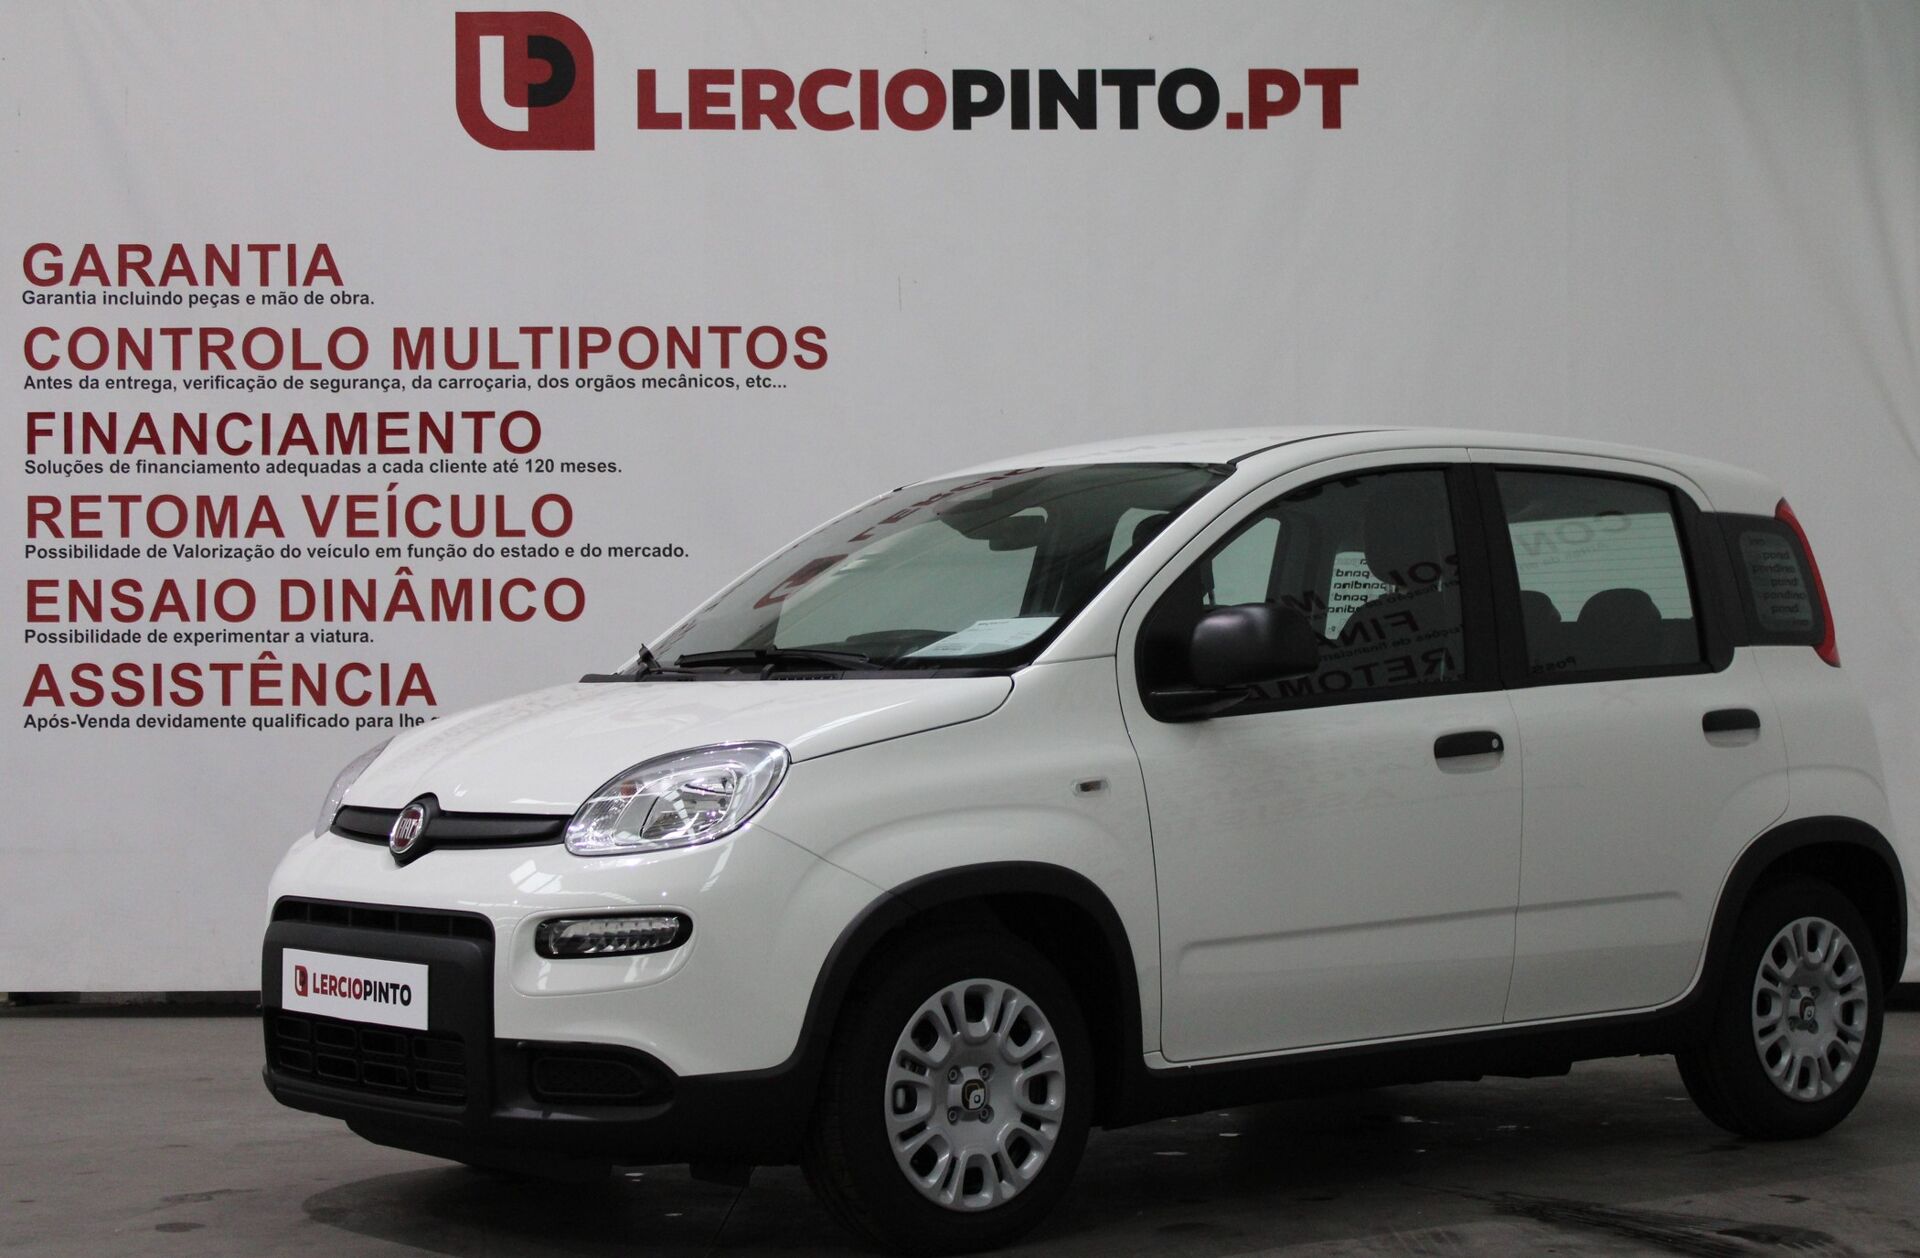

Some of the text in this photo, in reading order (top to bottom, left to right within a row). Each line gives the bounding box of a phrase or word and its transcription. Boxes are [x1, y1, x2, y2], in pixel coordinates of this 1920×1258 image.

[636, 68, 1360, 131] LERCIOPINTO.PT
[22, 242, 345, 288] GARANTIA
[21, 289, 375, 309] Garantia incluindo peças e mão de obra.
[23, 325, 829, 372] CONTROLO MULTIPONTOS
[23, 373, 787, 394] Antes da entrega, verificação de segurança, da carroçaria, dos orgãos mecânicos, etc...
[26, 409, 542, 457] FINANCIAMENTO
[24, 458, 622, 478] Soluções de financiamento adequadas a cada cliente até 120 meses.
[26, 481, 574, 540] RETOMA VEÍCULO
[24, 542, 689, 563] Possibilidade de Valorização do veículo em função do estado e do mercado.
[26, 566, 586, 624] ENSAIO DINÂMICO
[24, 628, 374, 647] Possibilidade de experimentar a viatura.
[22, 650, 438, 708] ASSISTÊNCIA
[23, 712, 425, 733] Após-Venda devidamente qualificado para lhe
[396, 817, 421, 840] FIAT
[312, 971, 412, 1006] LERCIOPINTO
